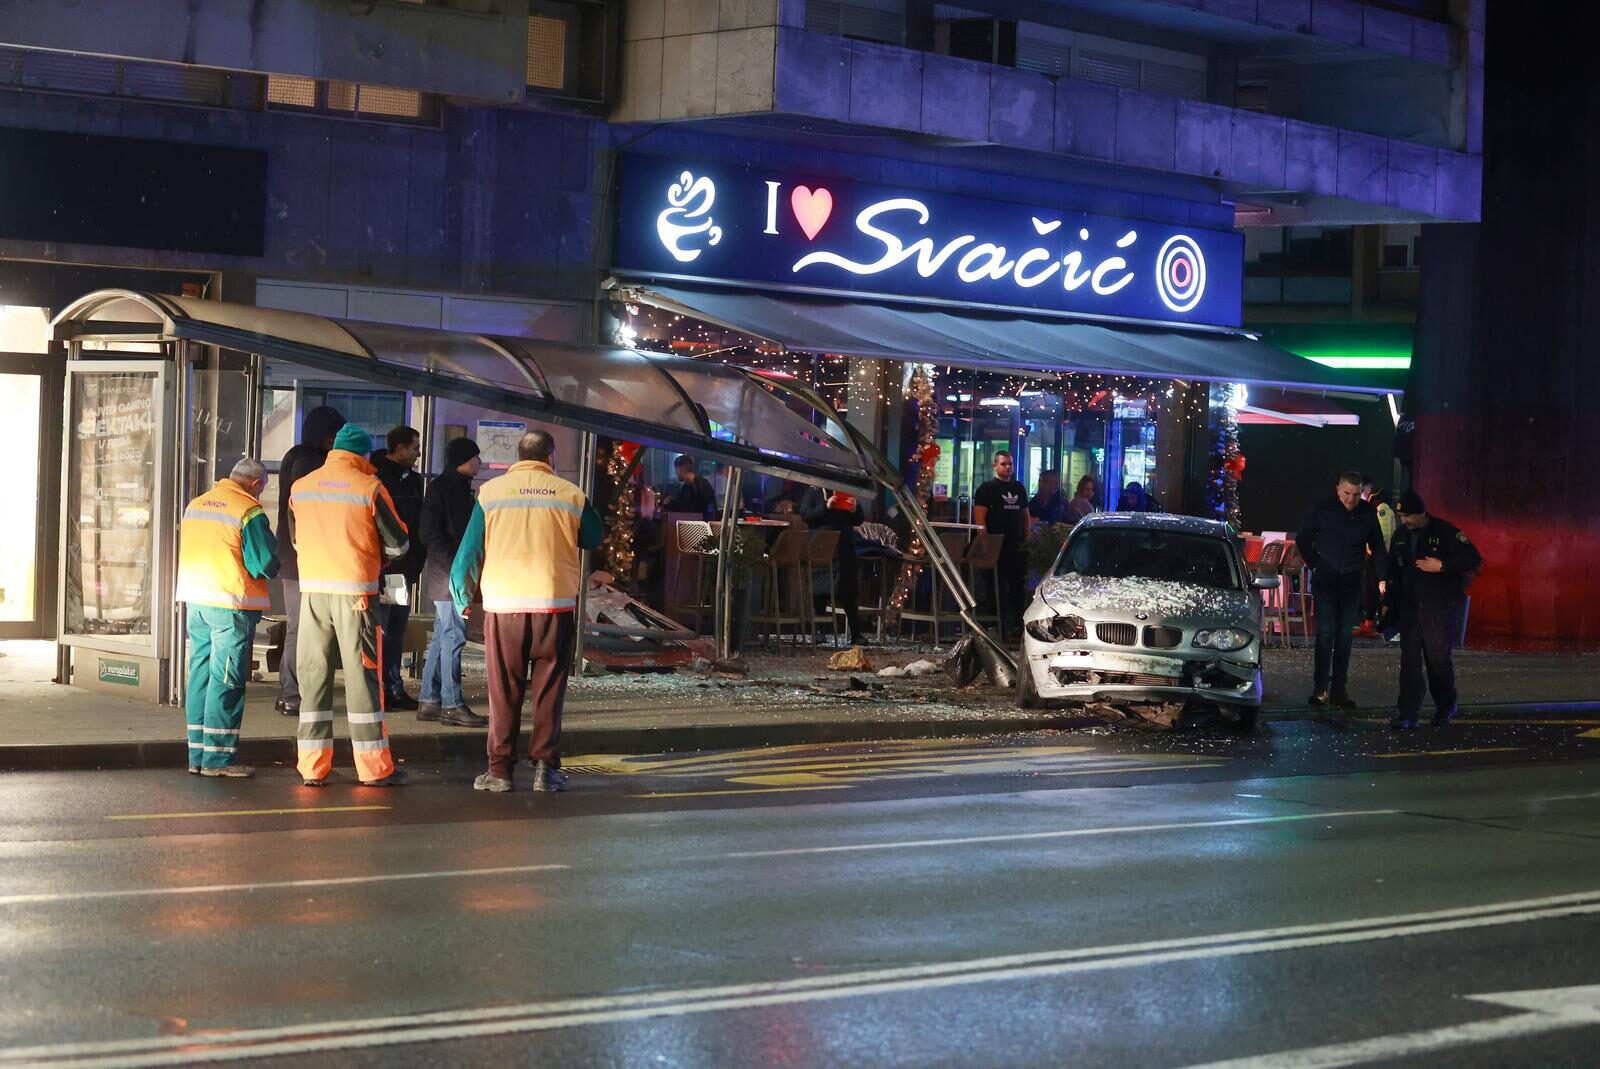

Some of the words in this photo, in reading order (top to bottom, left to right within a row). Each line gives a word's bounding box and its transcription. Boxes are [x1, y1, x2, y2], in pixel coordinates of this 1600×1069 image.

[763, 180, 782, 235] I
[792, 198, 1137, 297] Svačić
[118, 397, 152, 413] GAMING
[318, 480, 353, 489] UNIKOM
[519, 488, 557, 496] UNIKOM
[202, 499, 228, 508] UNIKOM
